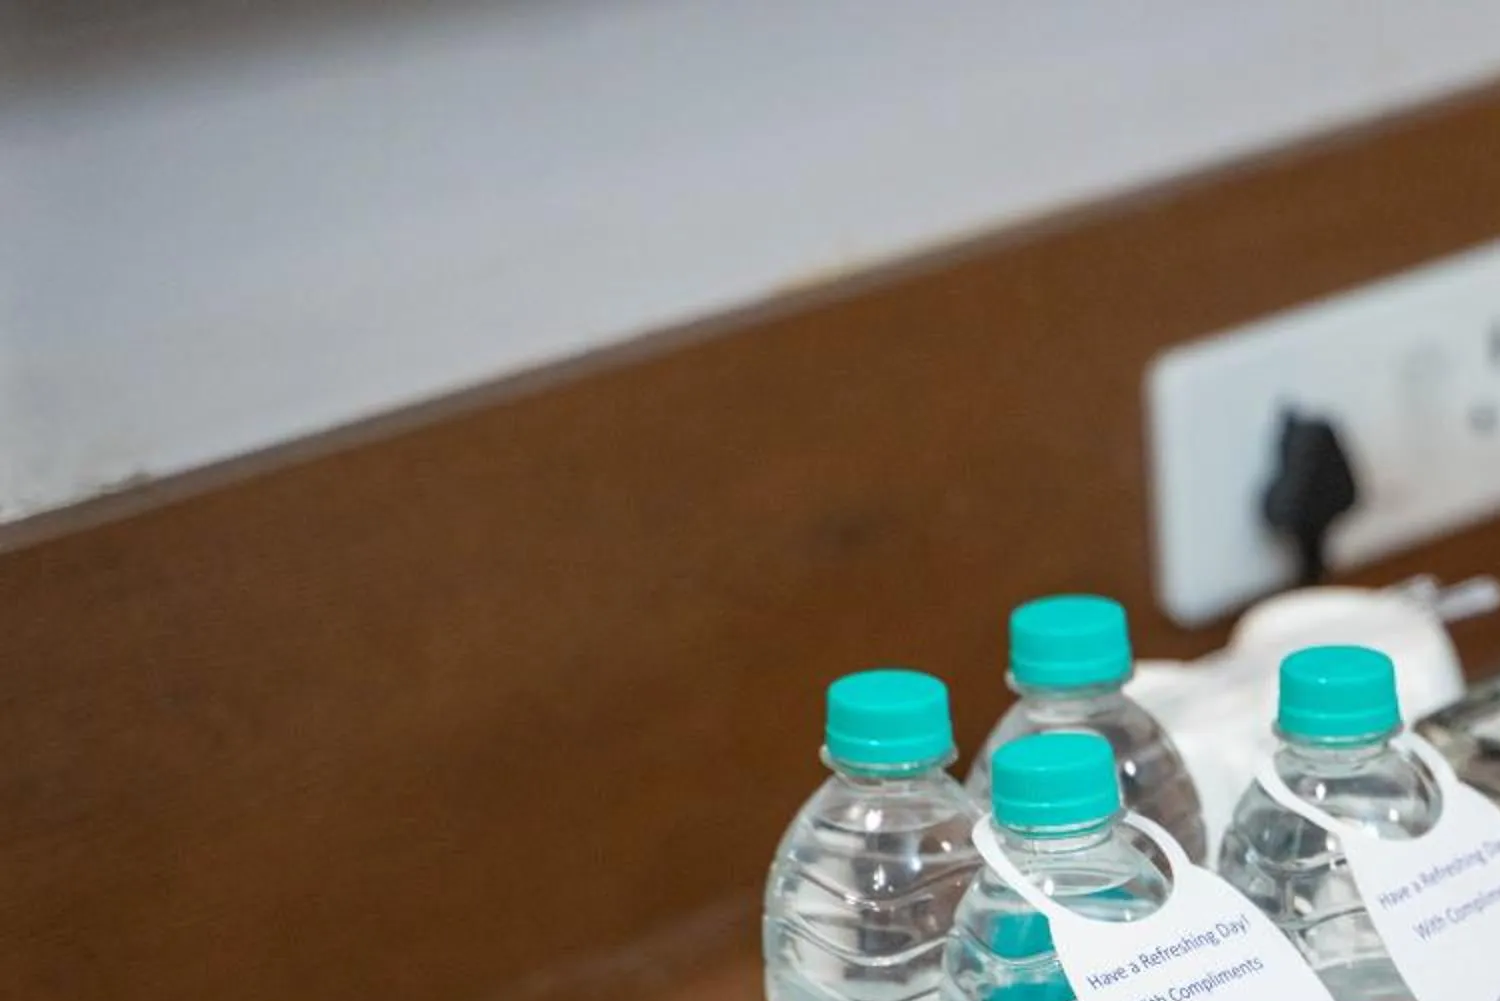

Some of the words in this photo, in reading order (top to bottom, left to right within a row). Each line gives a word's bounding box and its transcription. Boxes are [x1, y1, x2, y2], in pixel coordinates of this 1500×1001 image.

[1086, 966, 1129, 990] Have
[1129, 961, 1141, 974] a
[1139, 930, 1221, 970] Refreshing
[1215, 914, 1250, 938] Day!
